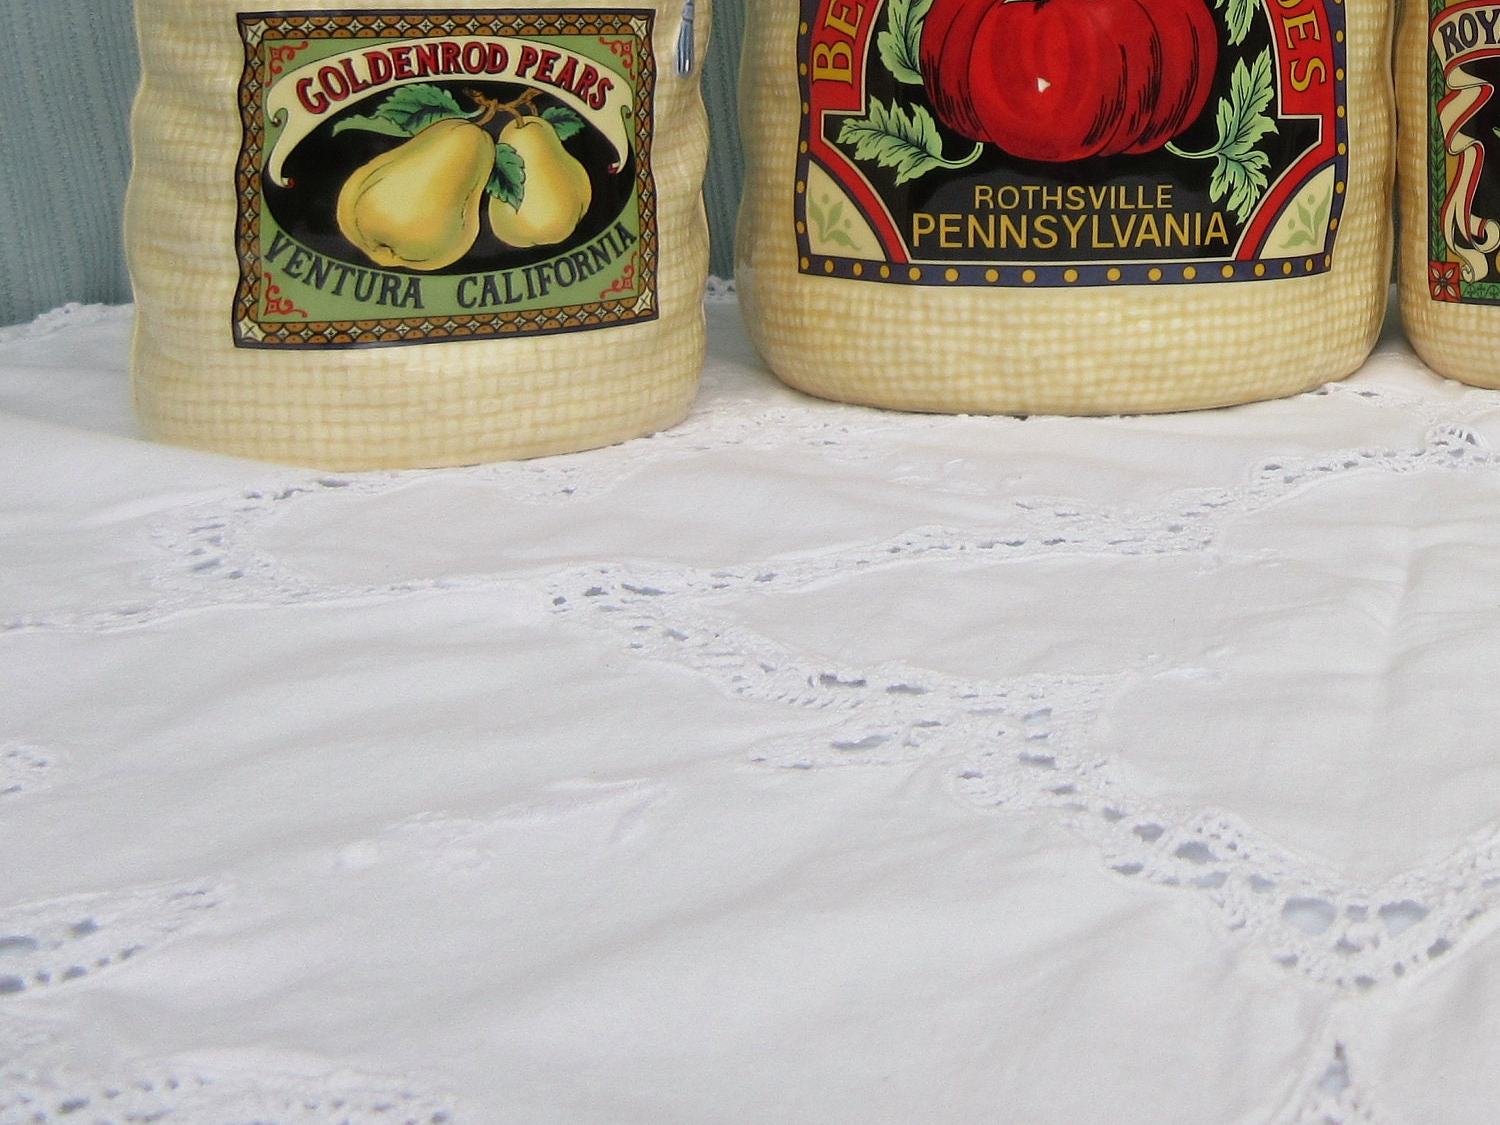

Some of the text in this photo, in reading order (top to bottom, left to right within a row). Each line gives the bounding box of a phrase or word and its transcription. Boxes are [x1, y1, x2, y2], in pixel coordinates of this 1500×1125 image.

[295, 41, 615, 115] GOLDENROD PEARS
[973, 184, 1173, 210] ROTHSVILLE
[911, 212, 1230, 250] PENNSYLVANIA
[263, 221, 638, 310] VENTURA CALIFORNIA
